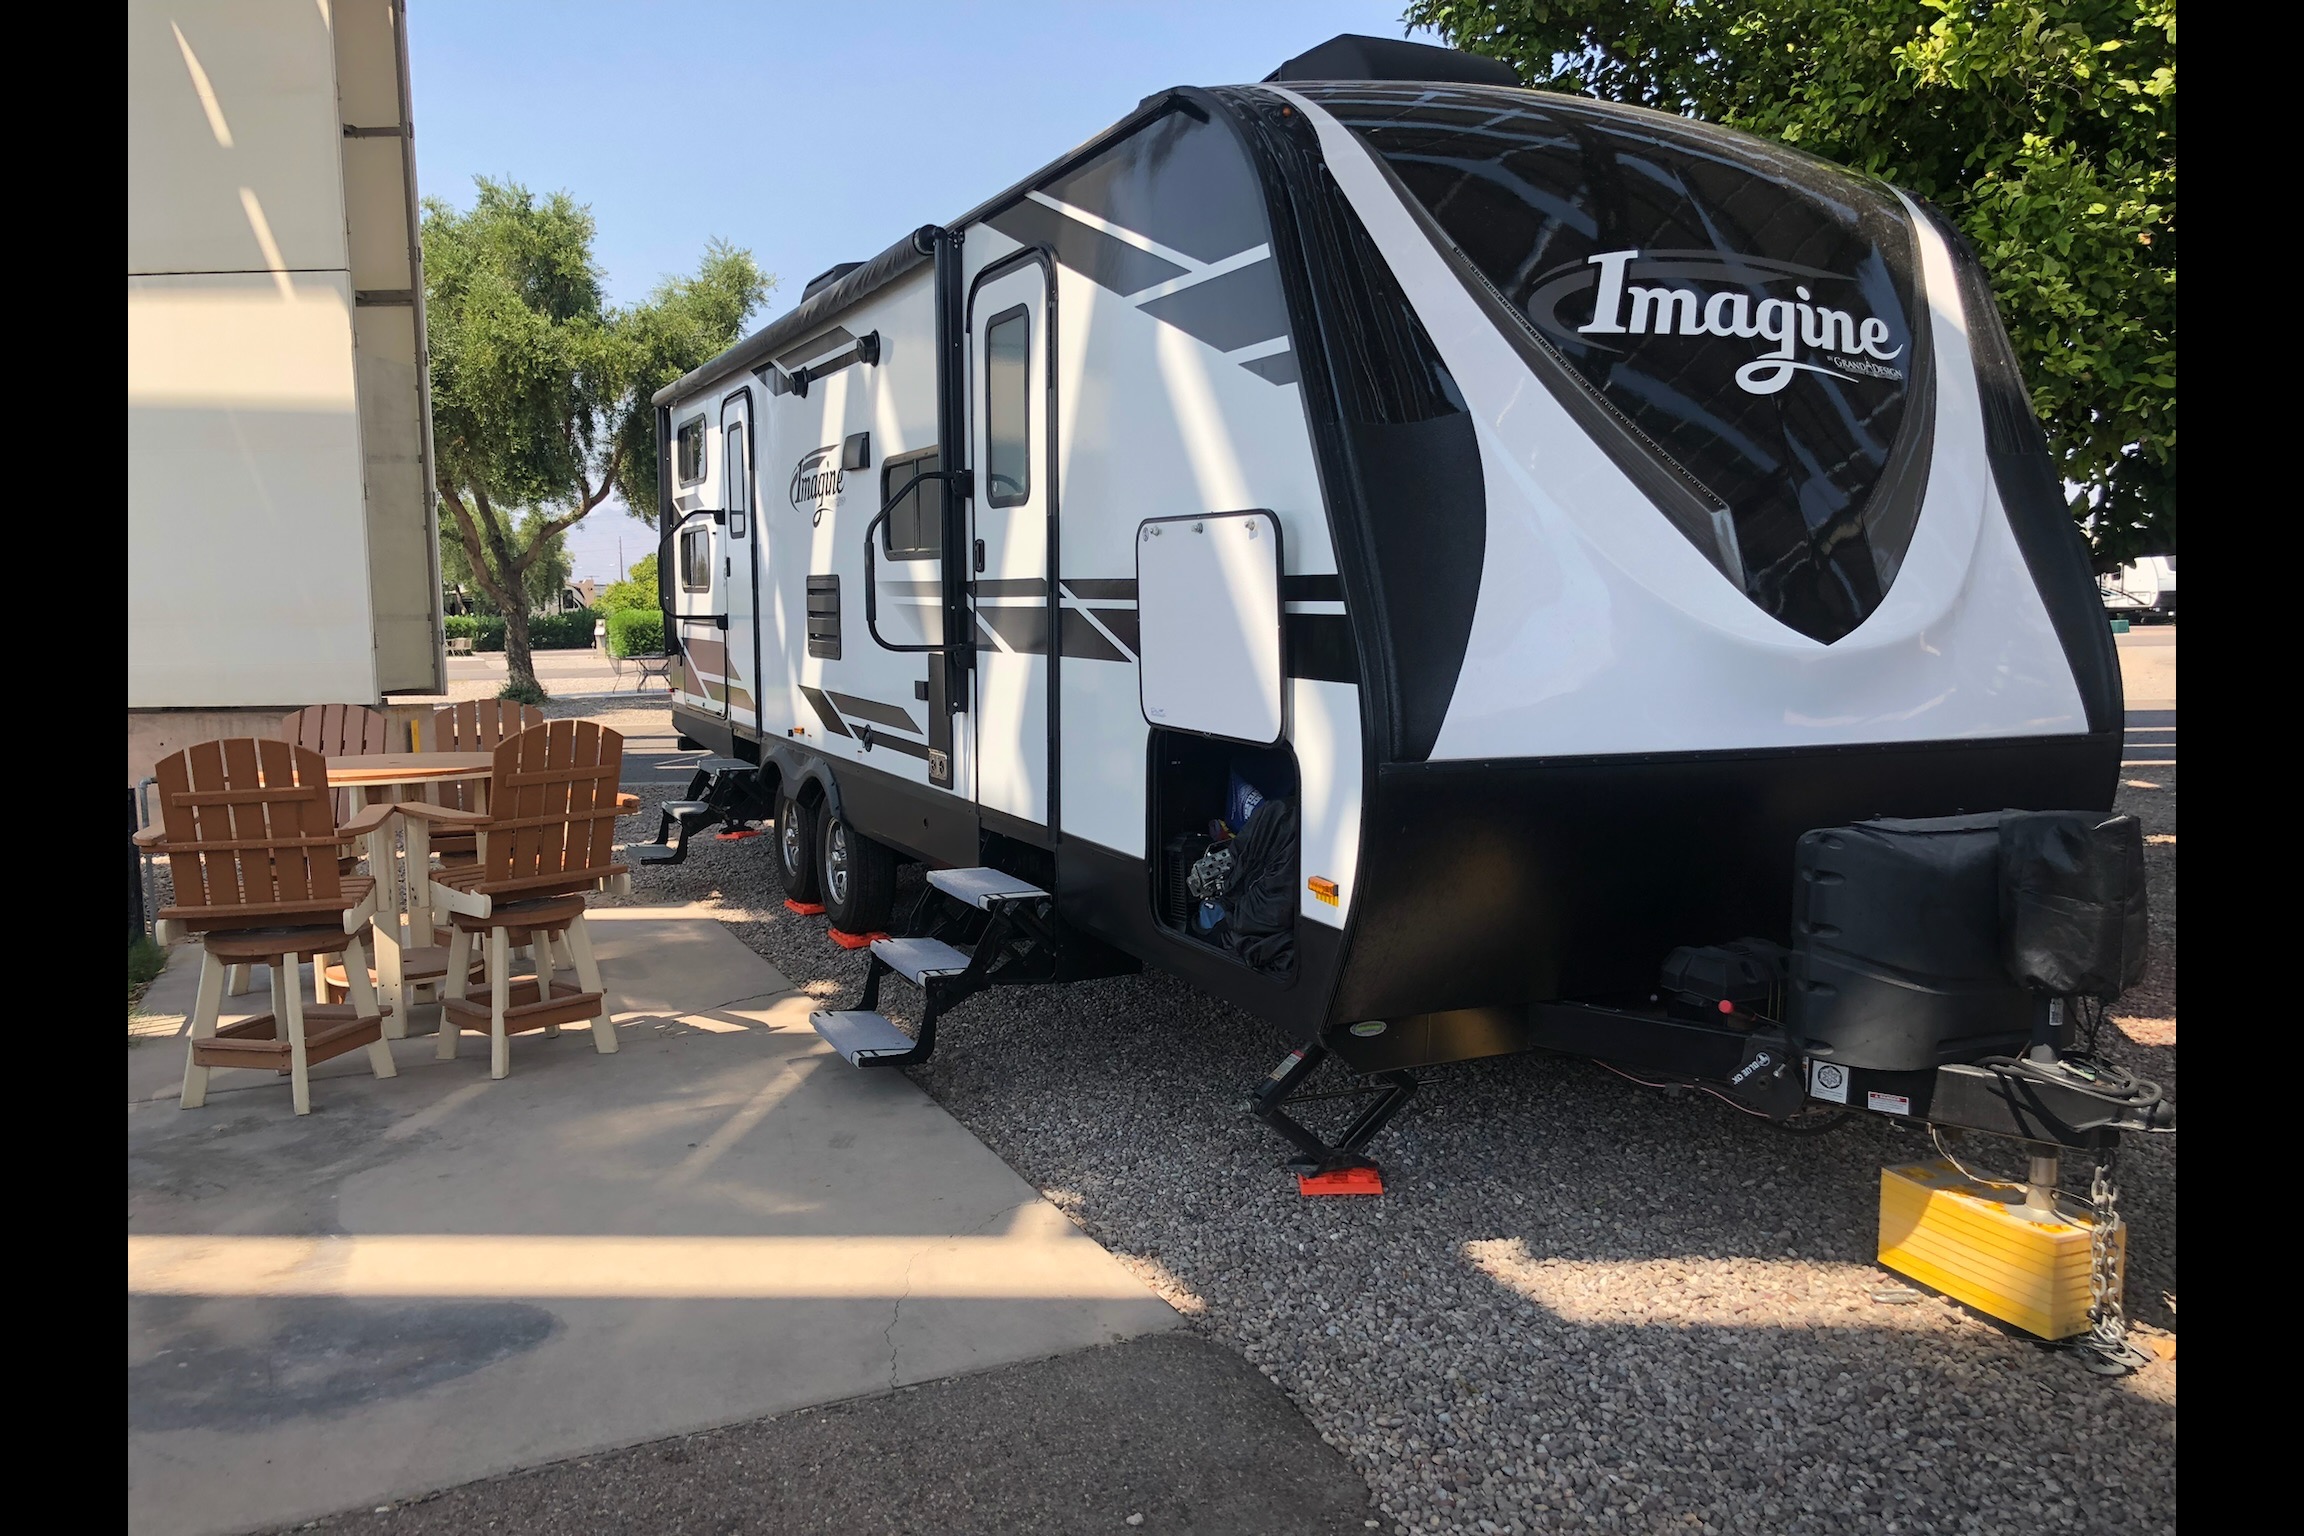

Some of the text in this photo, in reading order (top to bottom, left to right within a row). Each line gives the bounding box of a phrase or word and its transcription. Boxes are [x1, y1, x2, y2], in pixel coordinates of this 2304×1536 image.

[1577, 249, 1903, 395] Imagine
[794, 458, 846, 529] Imagine
[1731, 1060, 1760, 1086] BLUE OX
